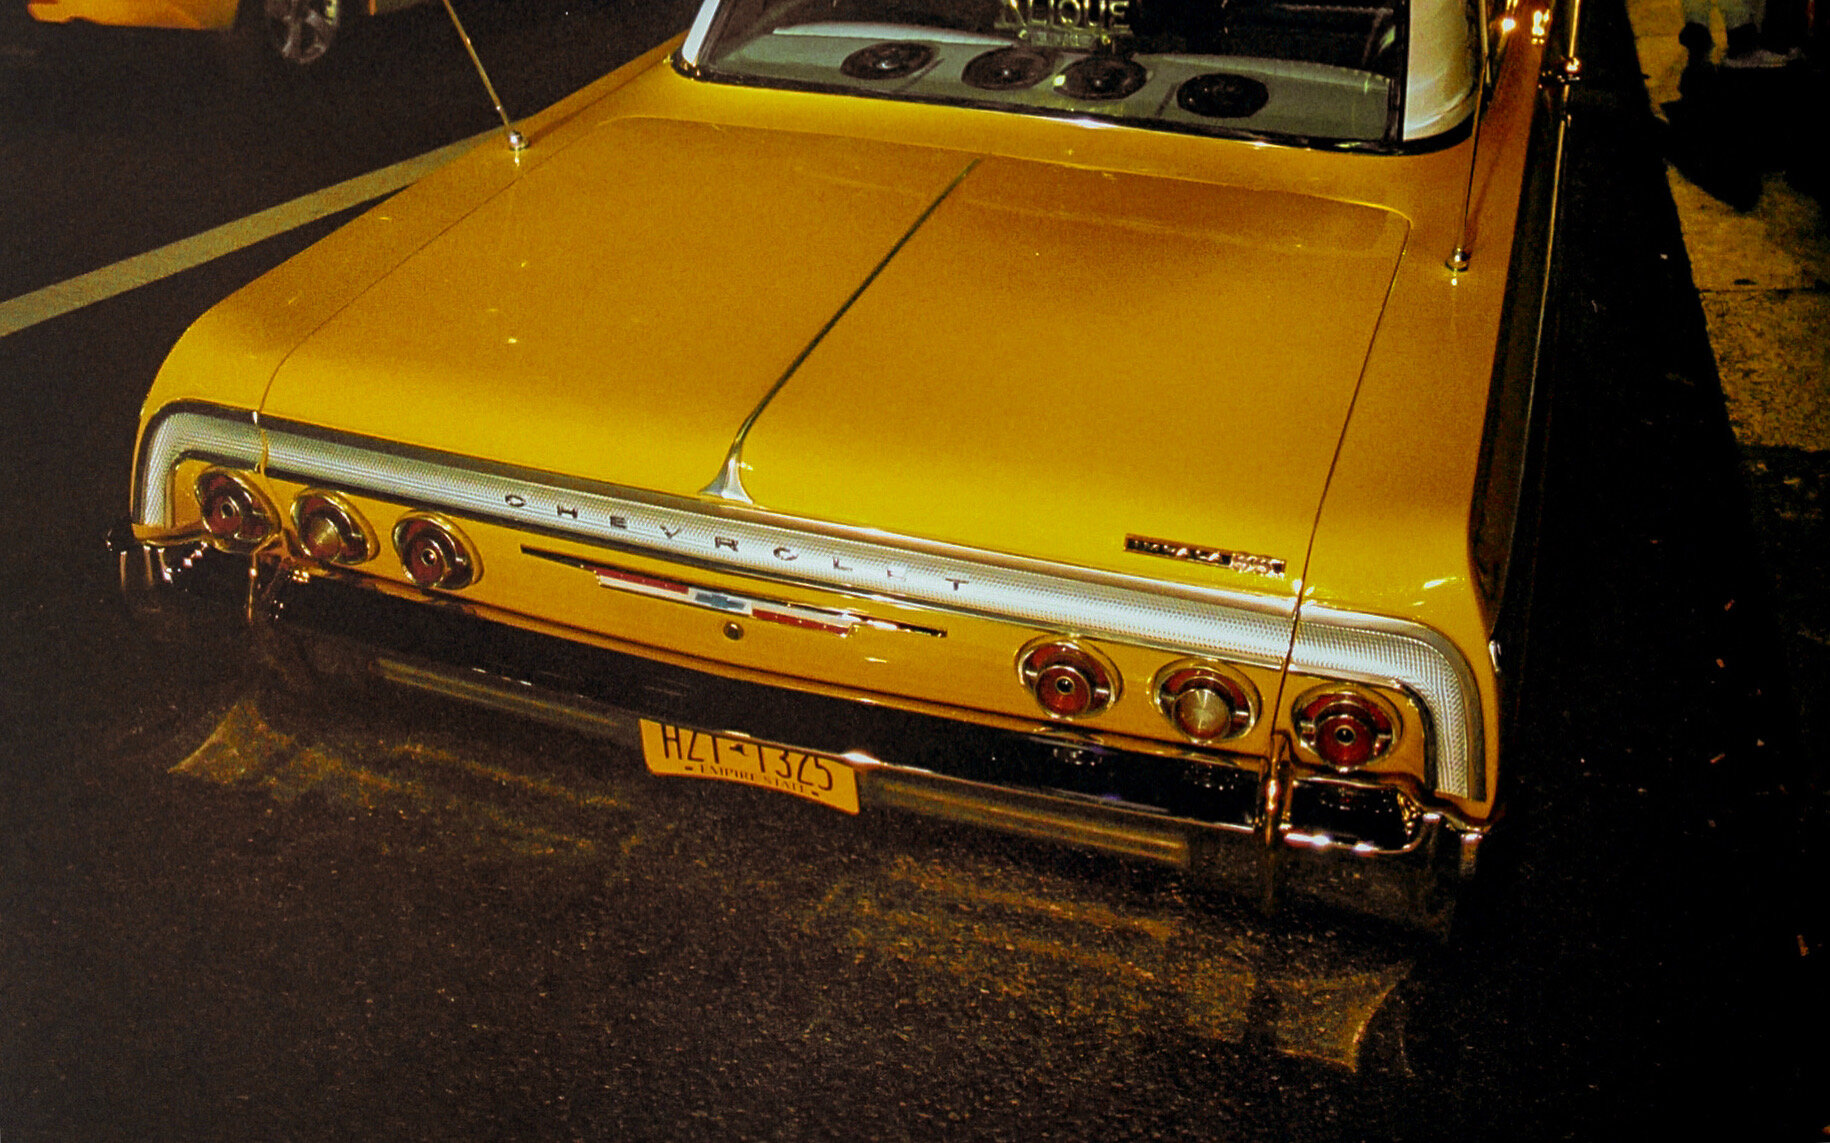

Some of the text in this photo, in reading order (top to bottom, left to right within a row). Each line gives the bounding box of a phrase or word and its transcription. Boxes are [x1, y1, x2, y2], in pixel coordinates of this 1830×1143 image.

[504, 494, 969, 591] CHEVROLET
[700, 763, 806, 793] EMPIRE STATE
